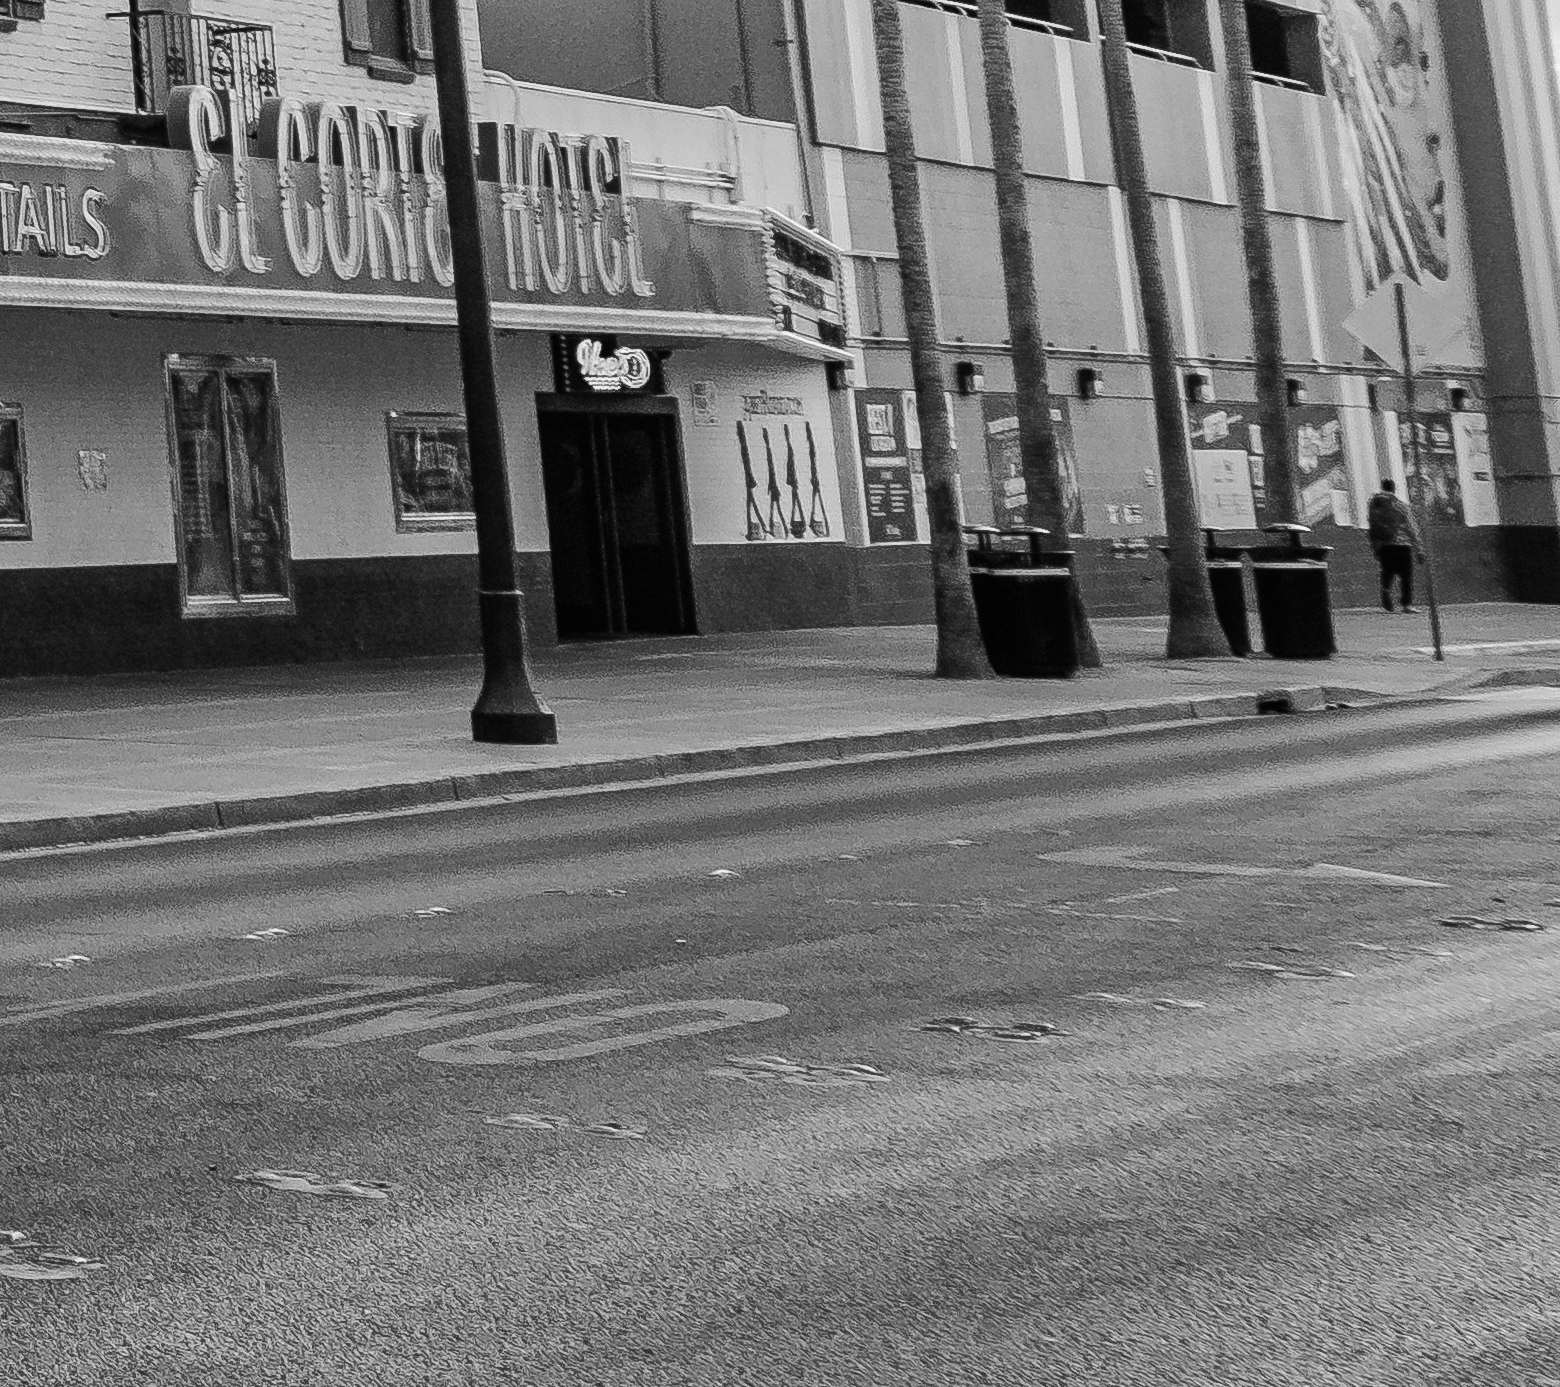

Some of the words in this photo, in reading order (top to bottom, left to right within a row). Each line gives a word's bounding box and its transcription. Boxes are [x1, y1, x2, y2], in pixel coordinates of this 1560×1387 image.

[170, 85, 272, 274] EL
[259, 95, 456, 288] CORTE
[487, 122, 655, 298] HOTEL
